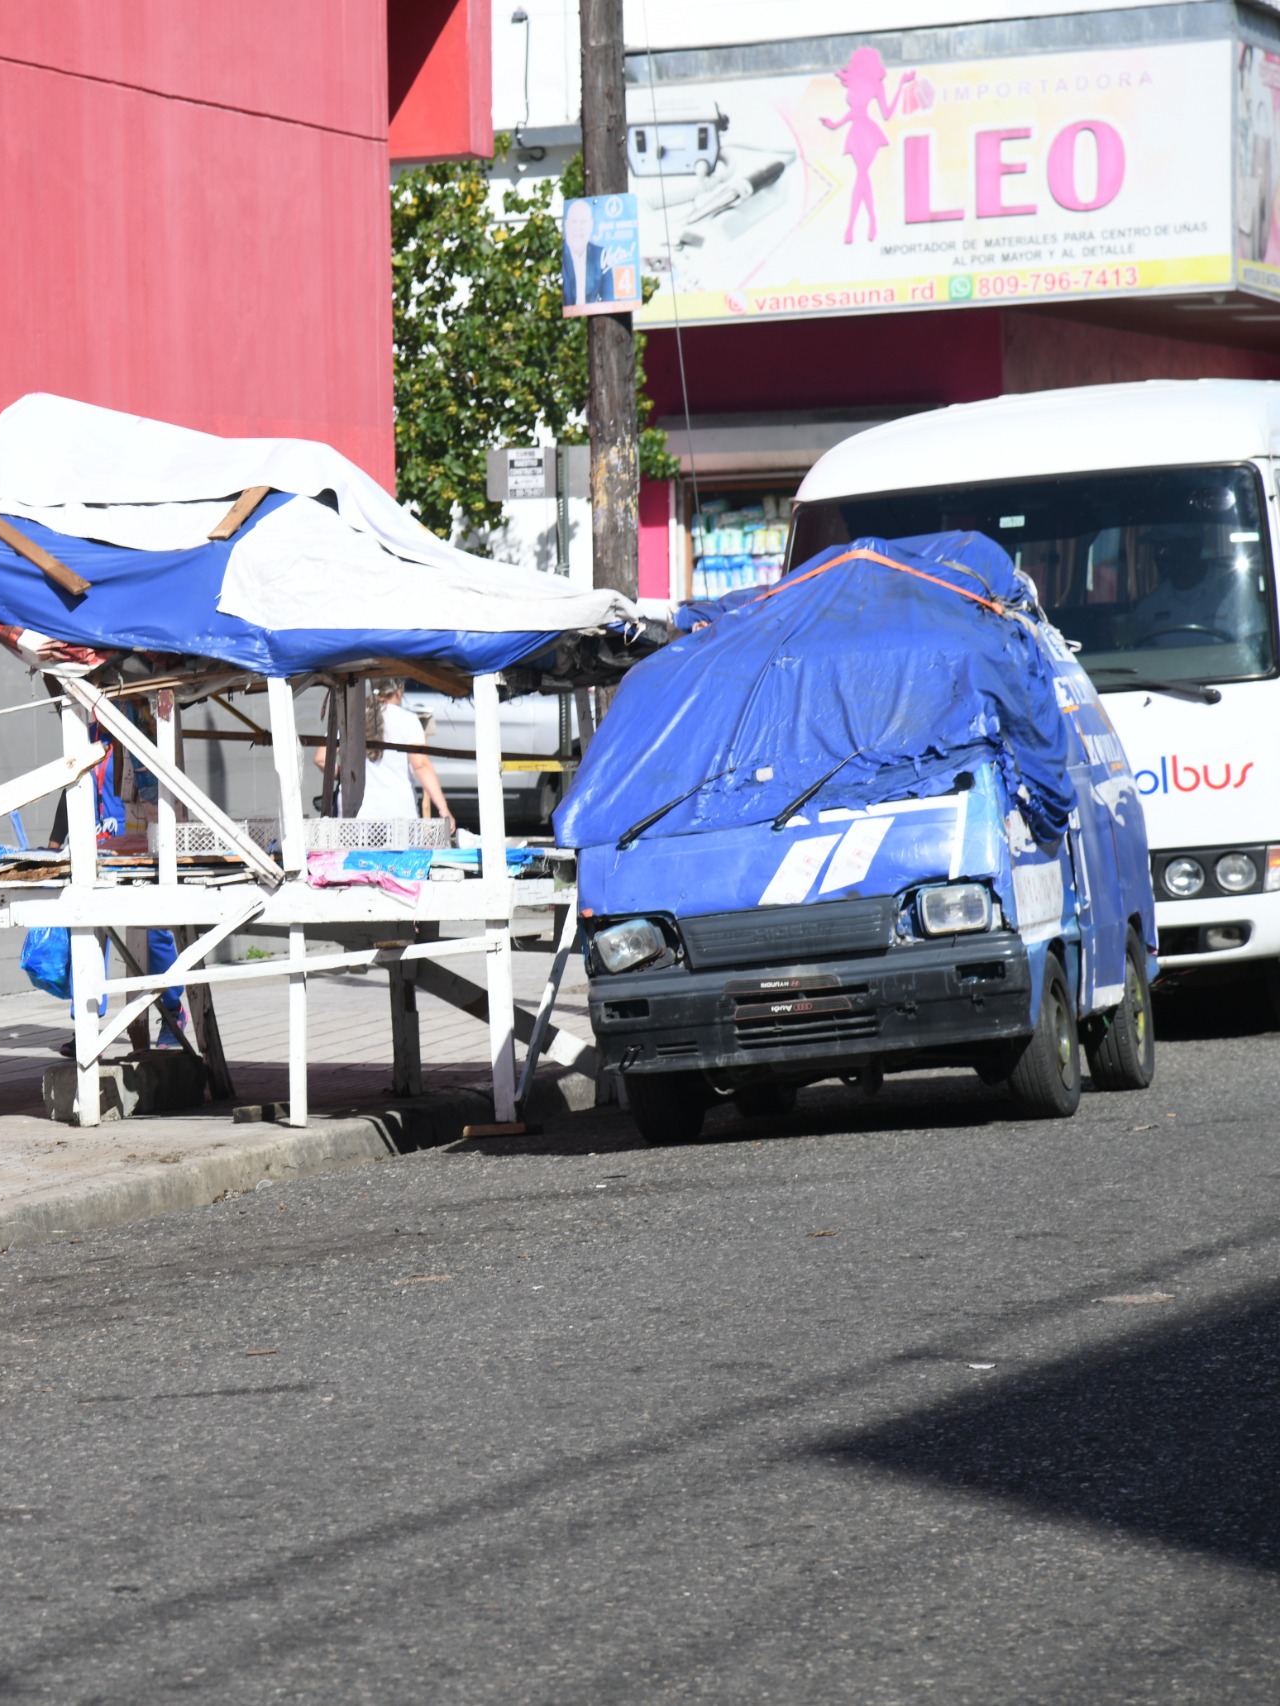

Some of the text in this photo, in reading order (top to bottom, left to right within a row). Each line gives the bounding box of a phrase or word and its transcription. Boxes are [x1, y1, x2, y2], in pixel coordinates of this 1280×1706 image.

[941, 71, 1155, 102] IMPORTADORA
[904, 119, 1126, 225] LEO
[880, 240, 957, 257] IMPORTADOR
[962, 238, 977, 251] DE
[984, 232, 1058, 249] MATERIALES
[1063, 230, 1095, 243] PARA
[1100, 226, 1151, 241] CENTRO
[1154, 223, 1170, 237] DE
[952, 242, 1135, 267] AL POR MAYOR Y AL DETALLE
[618, 267, 634, 295] 4
[754, 266, 1138, 313] vanessauna rd 809-796-7413
